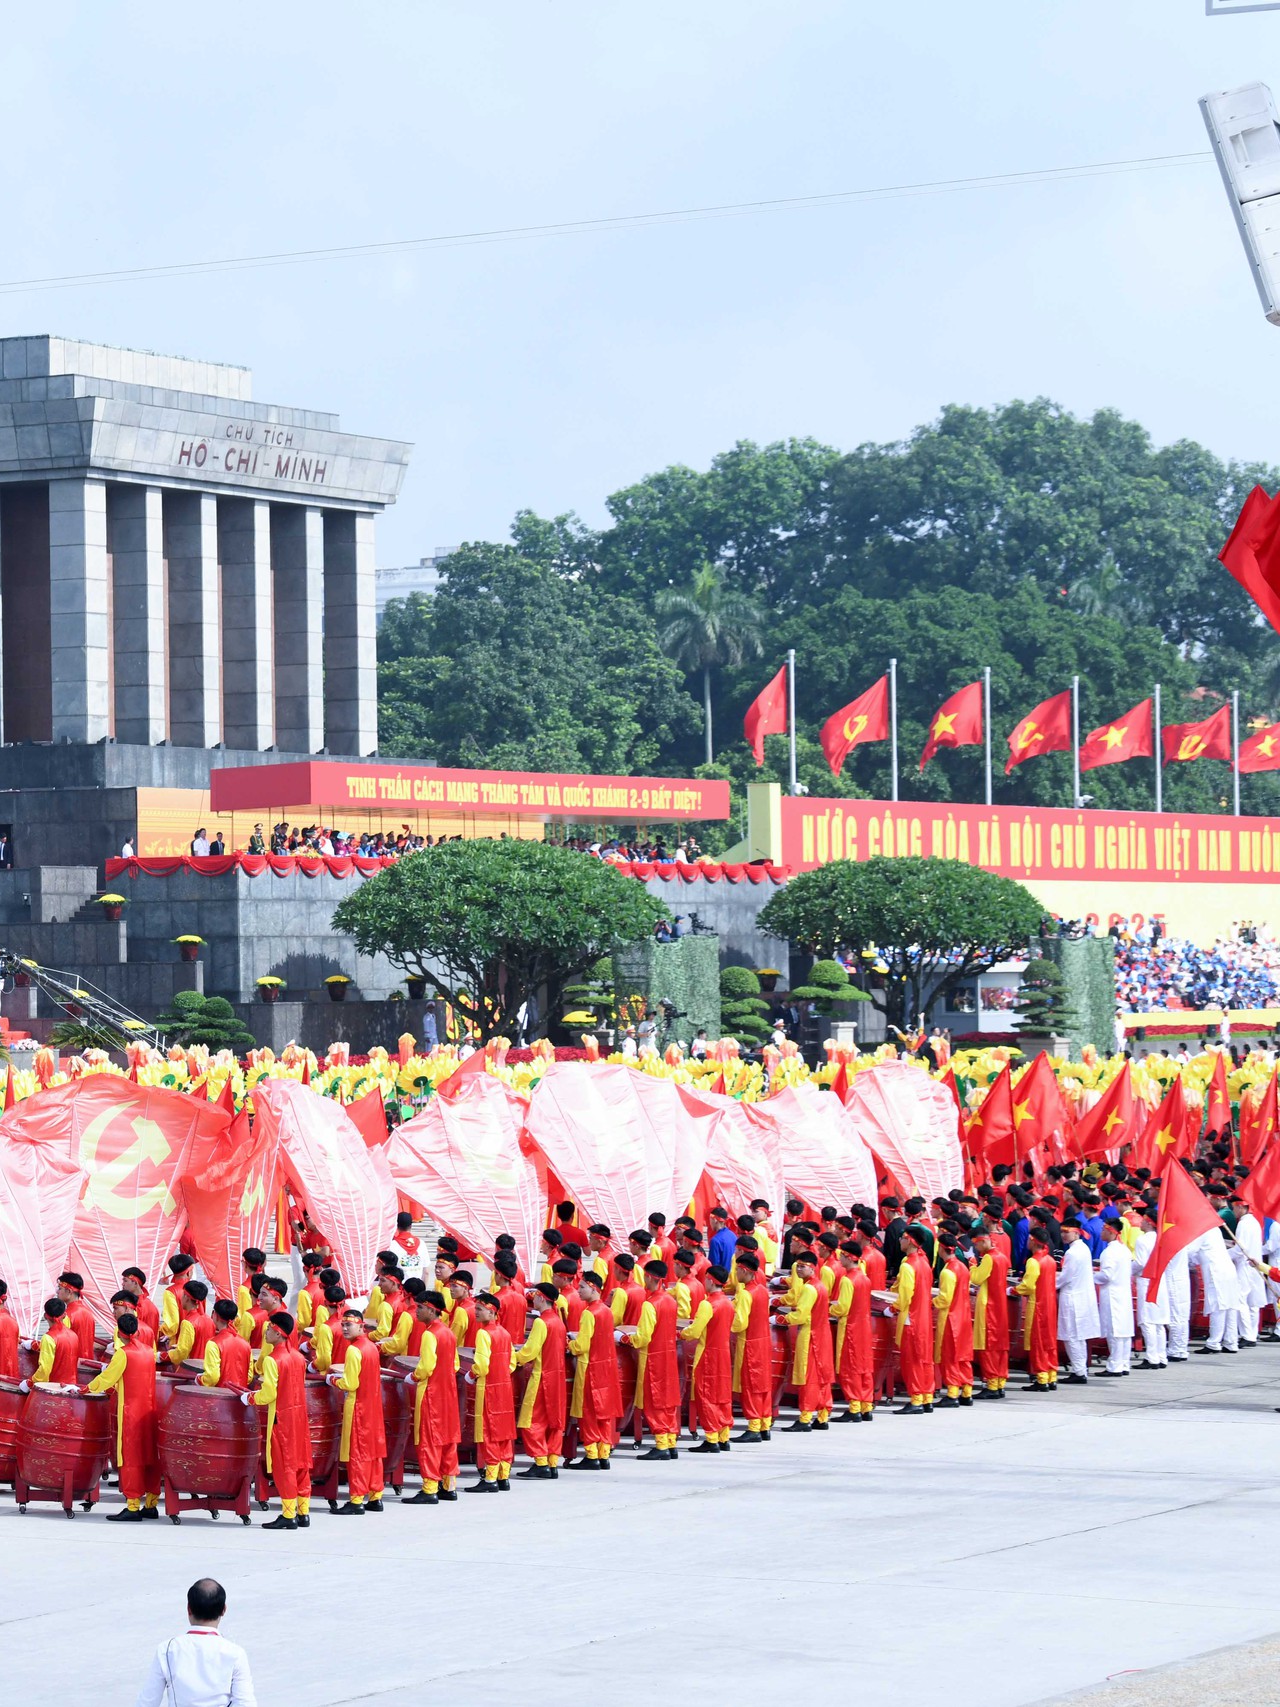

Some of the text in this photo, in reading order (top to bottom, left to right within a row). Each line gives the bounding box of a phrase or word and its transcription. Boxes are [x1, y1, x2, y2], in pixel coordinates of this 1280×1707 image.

[346, 776, 377, 799] TINH
[413, 775, 444, 802] CÁCH
[447, 781, 479, 806] MẠNG
[480, 780, 518, 805] THÁNG
[520, 781, 545, 806] TÁM
[546, 782, 562, 807] VÀ
[592, 784, 629, 809] KHÁNH
[630, 788, 650, 809] 2-9
[802, 807, 858, 863] NƯỚC
[931, 812, 969, 863] HÒA
[1009, 814, 1042, 876] HỘI
[1050, 814, 1086, 870] CHỦ
[1094, 820, 1148, 870] NGHĨA
[1153, 820, 1191, 879] VIỆT
[1197, 829, 1232, 871] NAM
